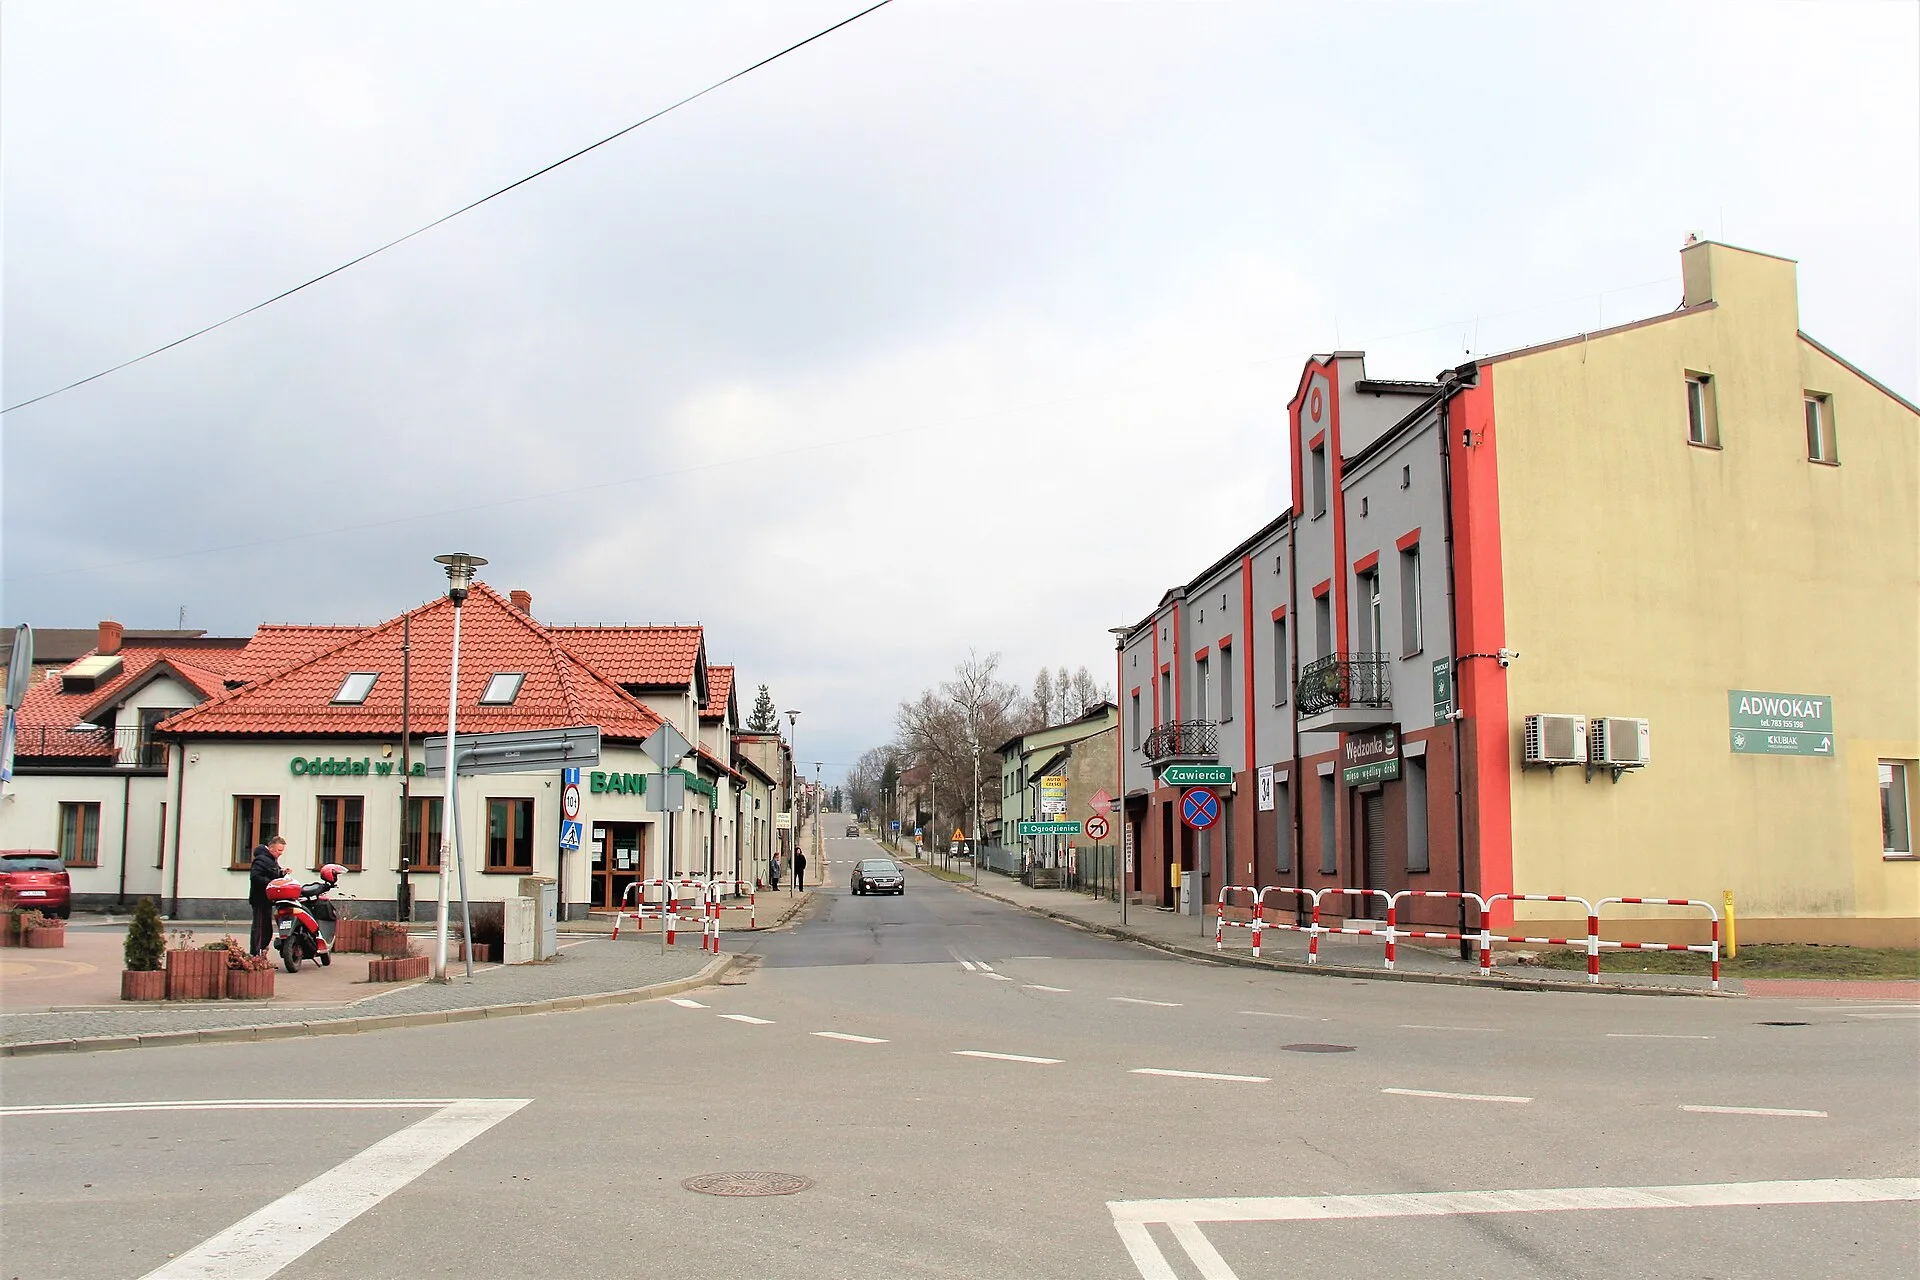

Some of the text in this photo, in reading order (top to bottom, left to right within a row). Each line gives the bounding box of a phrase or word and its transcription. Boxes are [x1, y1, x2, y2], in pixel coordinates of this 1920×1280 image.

[1739, 696, 1823, 718] ADWOKAT
[1771, 719, 1783, 728] 783
[1783, 720, 1793, 728] 155
[1346, 735, 1383, 763] Wędzonka
[290, 756, 371, 776] Oddział
[375, 761, 394, 776] w
[1172, 769, 1226, 781] Zawiercie
[1346, 761, 1396, 782] mięso wędliny drób
[1262, 777, 1270, 802] 34
[1031, 824, 1078, 835] Ogrodzieniec
